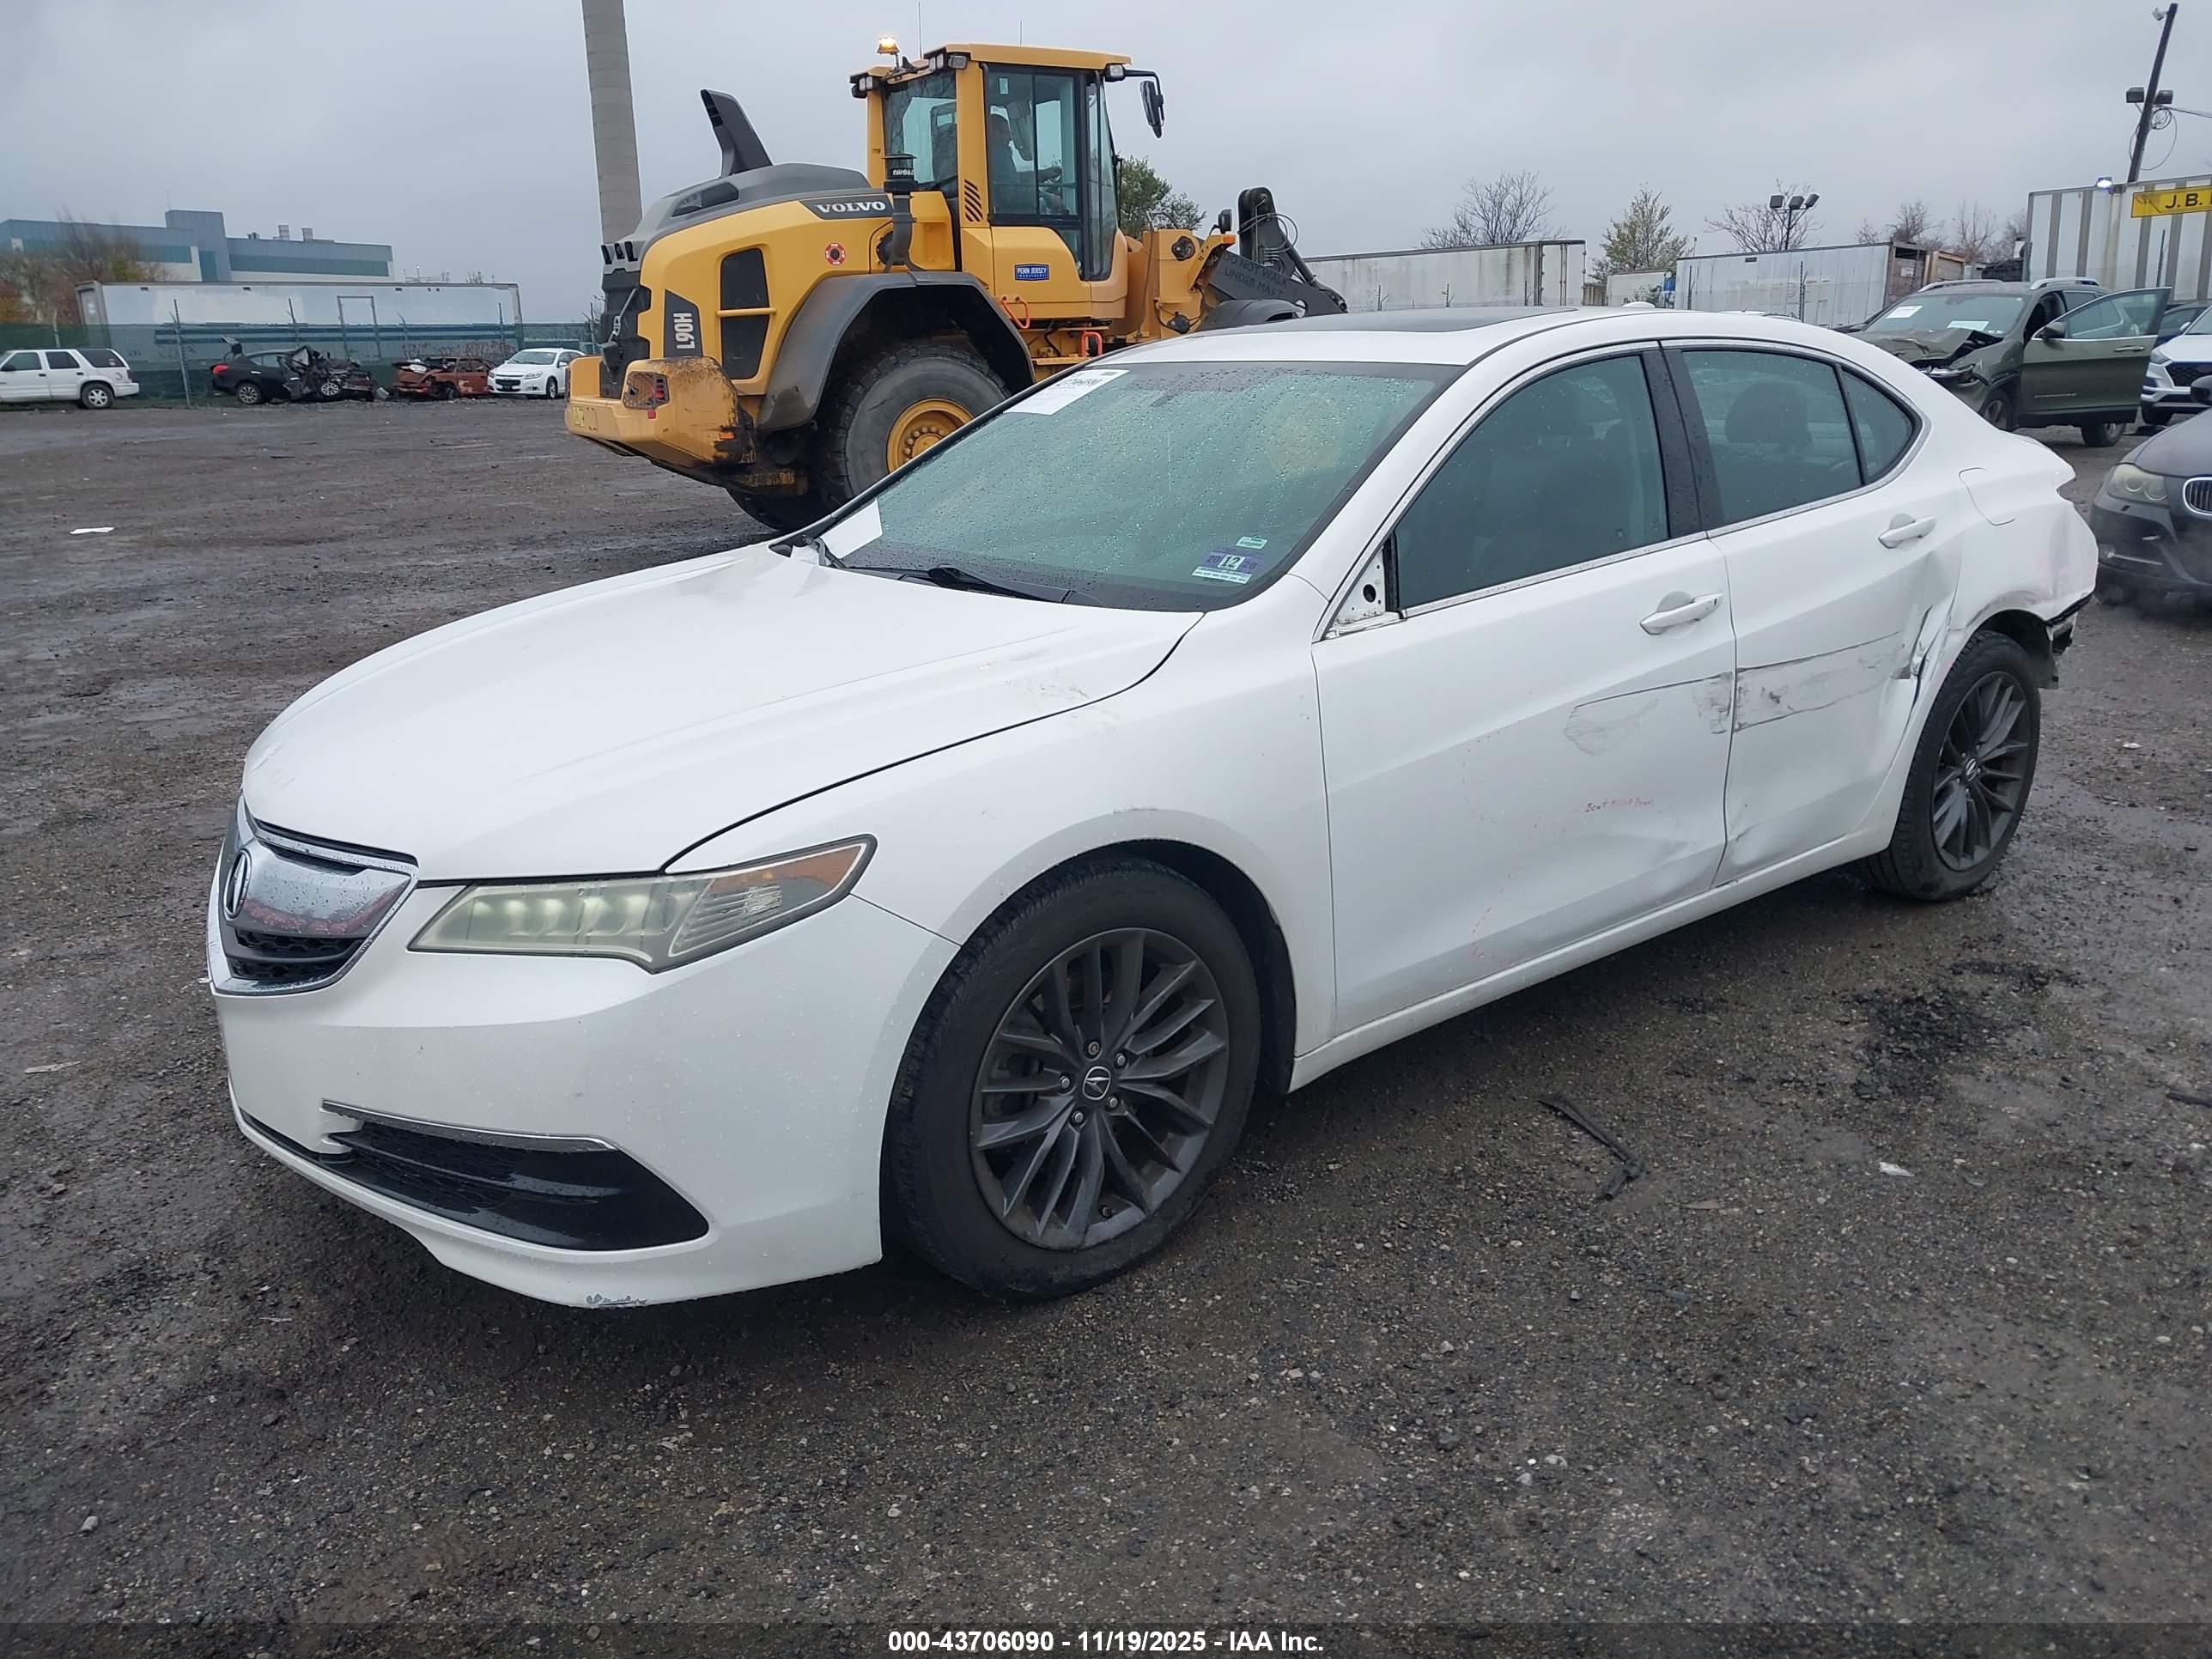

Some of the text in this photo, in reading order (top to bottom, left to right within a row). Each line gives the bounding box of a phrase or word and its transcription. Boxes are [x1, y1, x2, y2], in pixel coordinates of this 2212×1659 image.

[814, 201, 886, 213] VOLVO
[1224, 267, 1284, 297] UNDER MAST
[672, 312, 696, 349] L90H
[1221, 556, 1241, 568] 12
